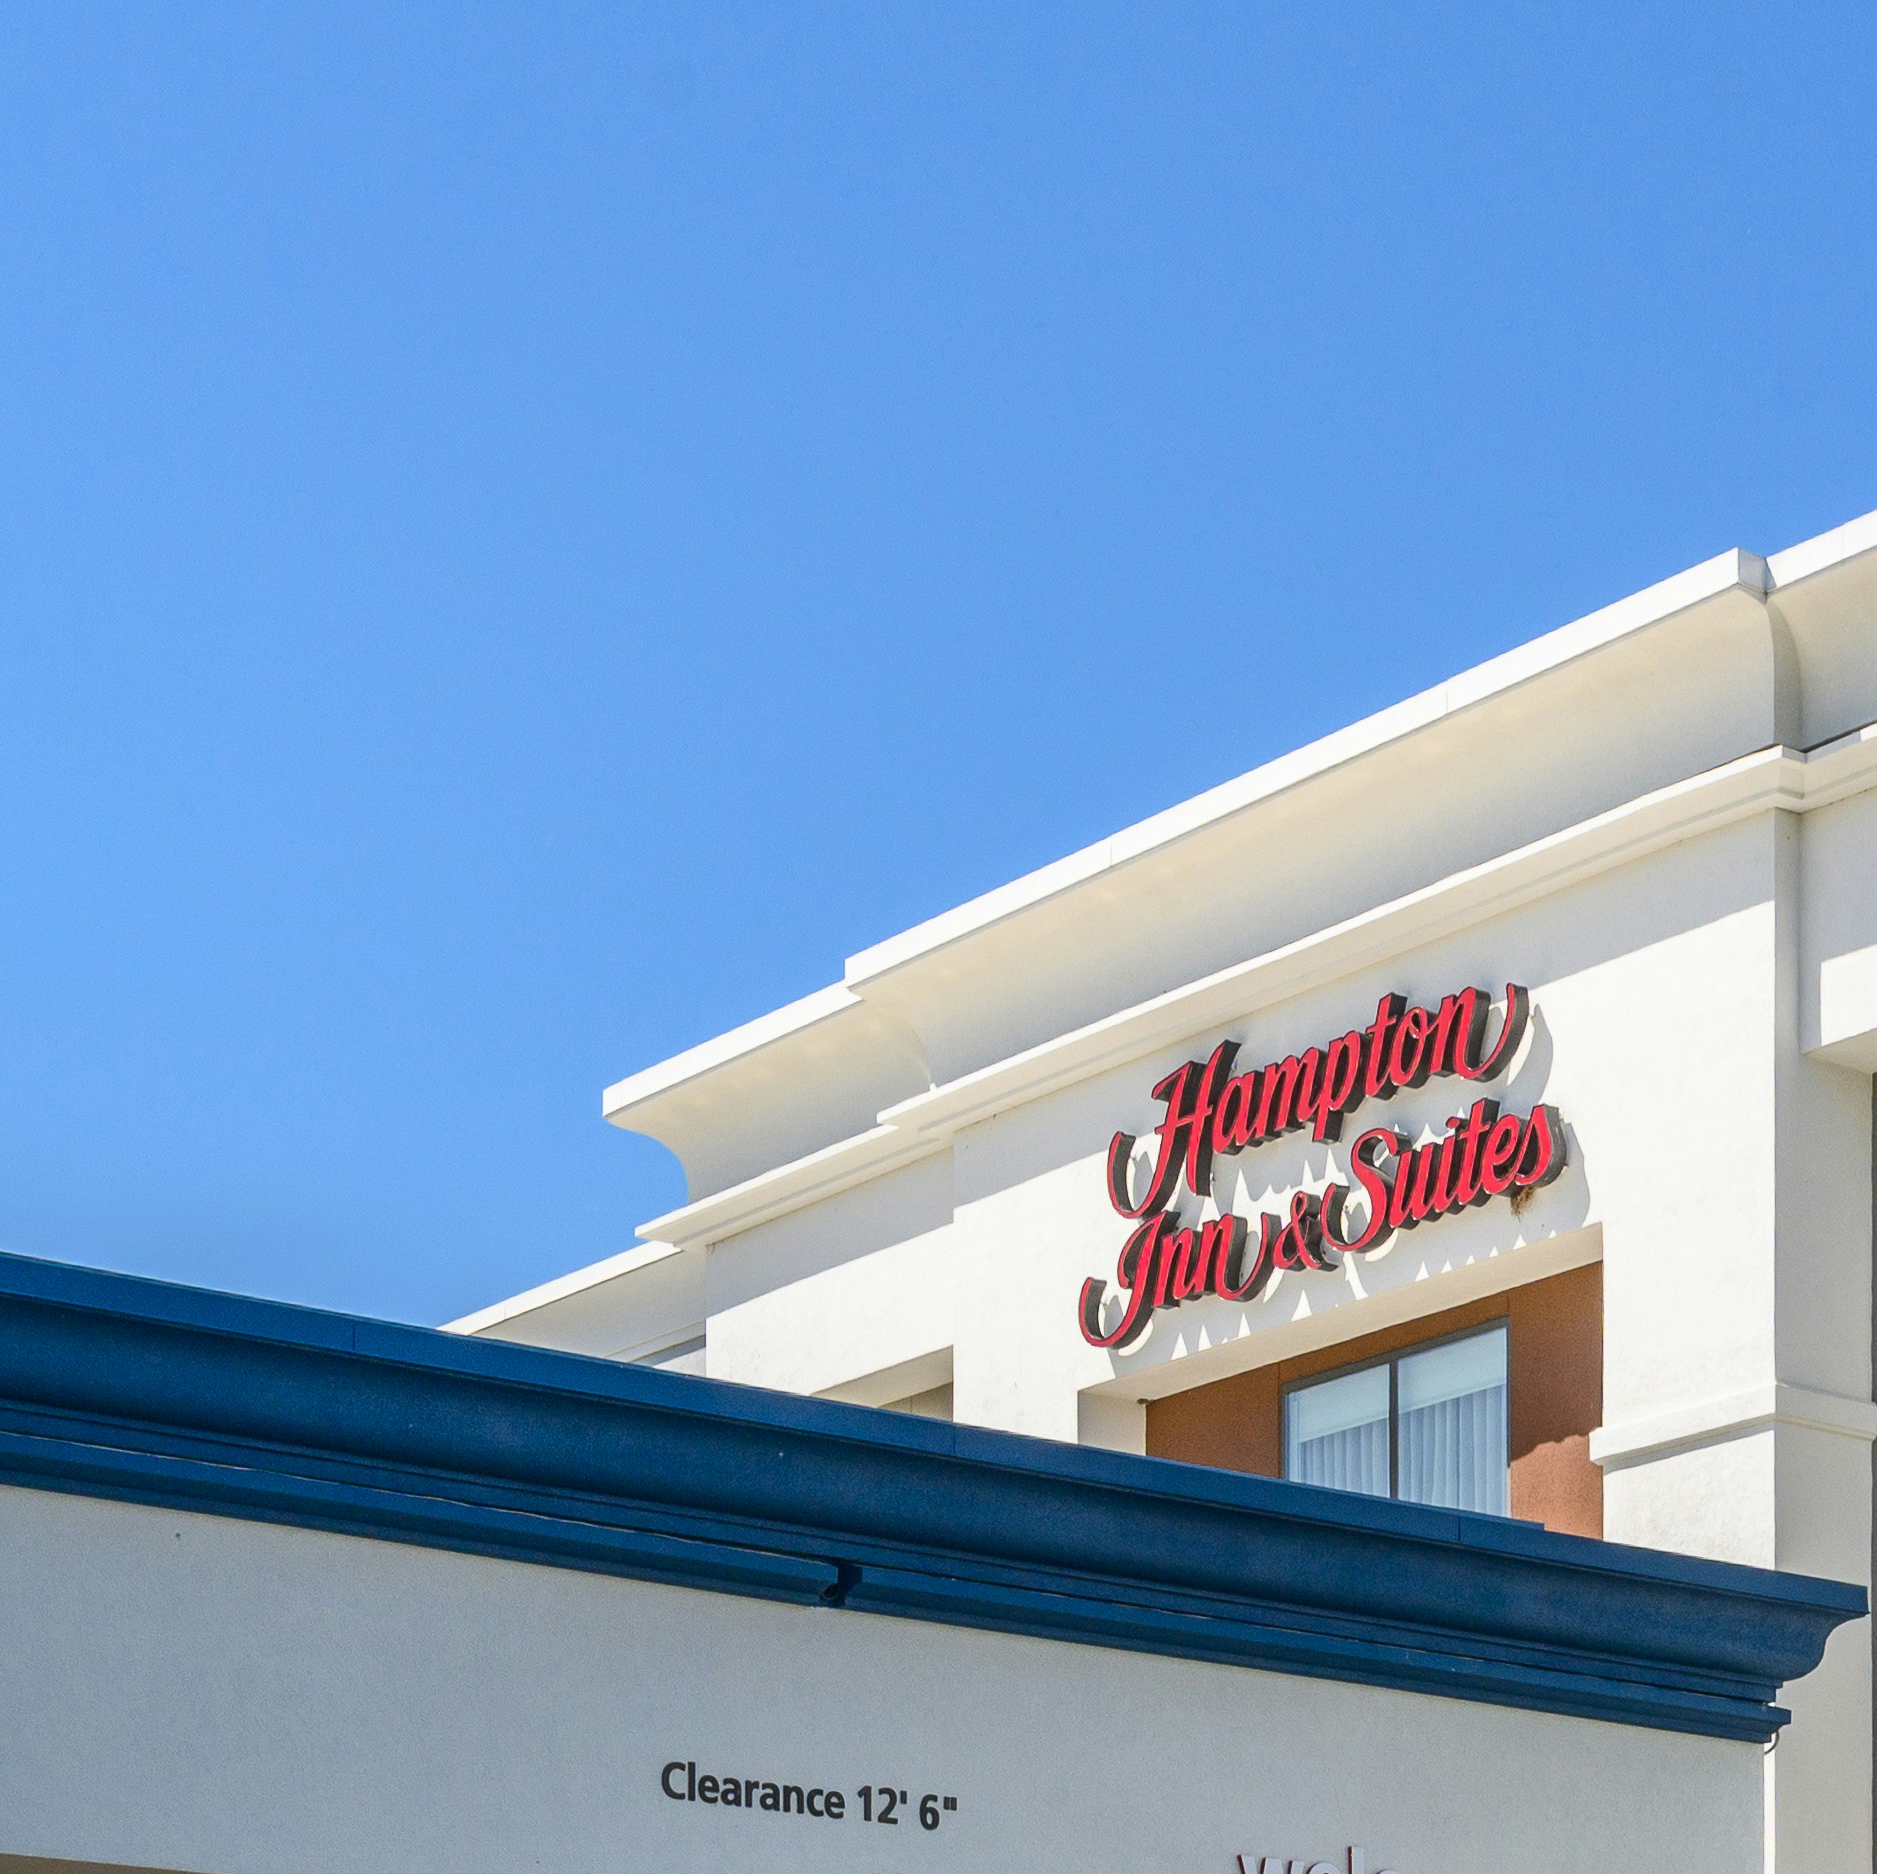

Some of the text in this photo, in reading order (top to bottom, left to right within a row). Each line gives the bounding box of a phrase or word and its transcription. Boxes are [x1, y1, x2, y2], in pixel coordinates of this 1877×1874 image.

[1107, 982, 1527, 1219] Hampton
[1078, 1097, 1561, 1349] Inn & Suites
[660, 1760, 958, 1831] Clearance 12' 6"
